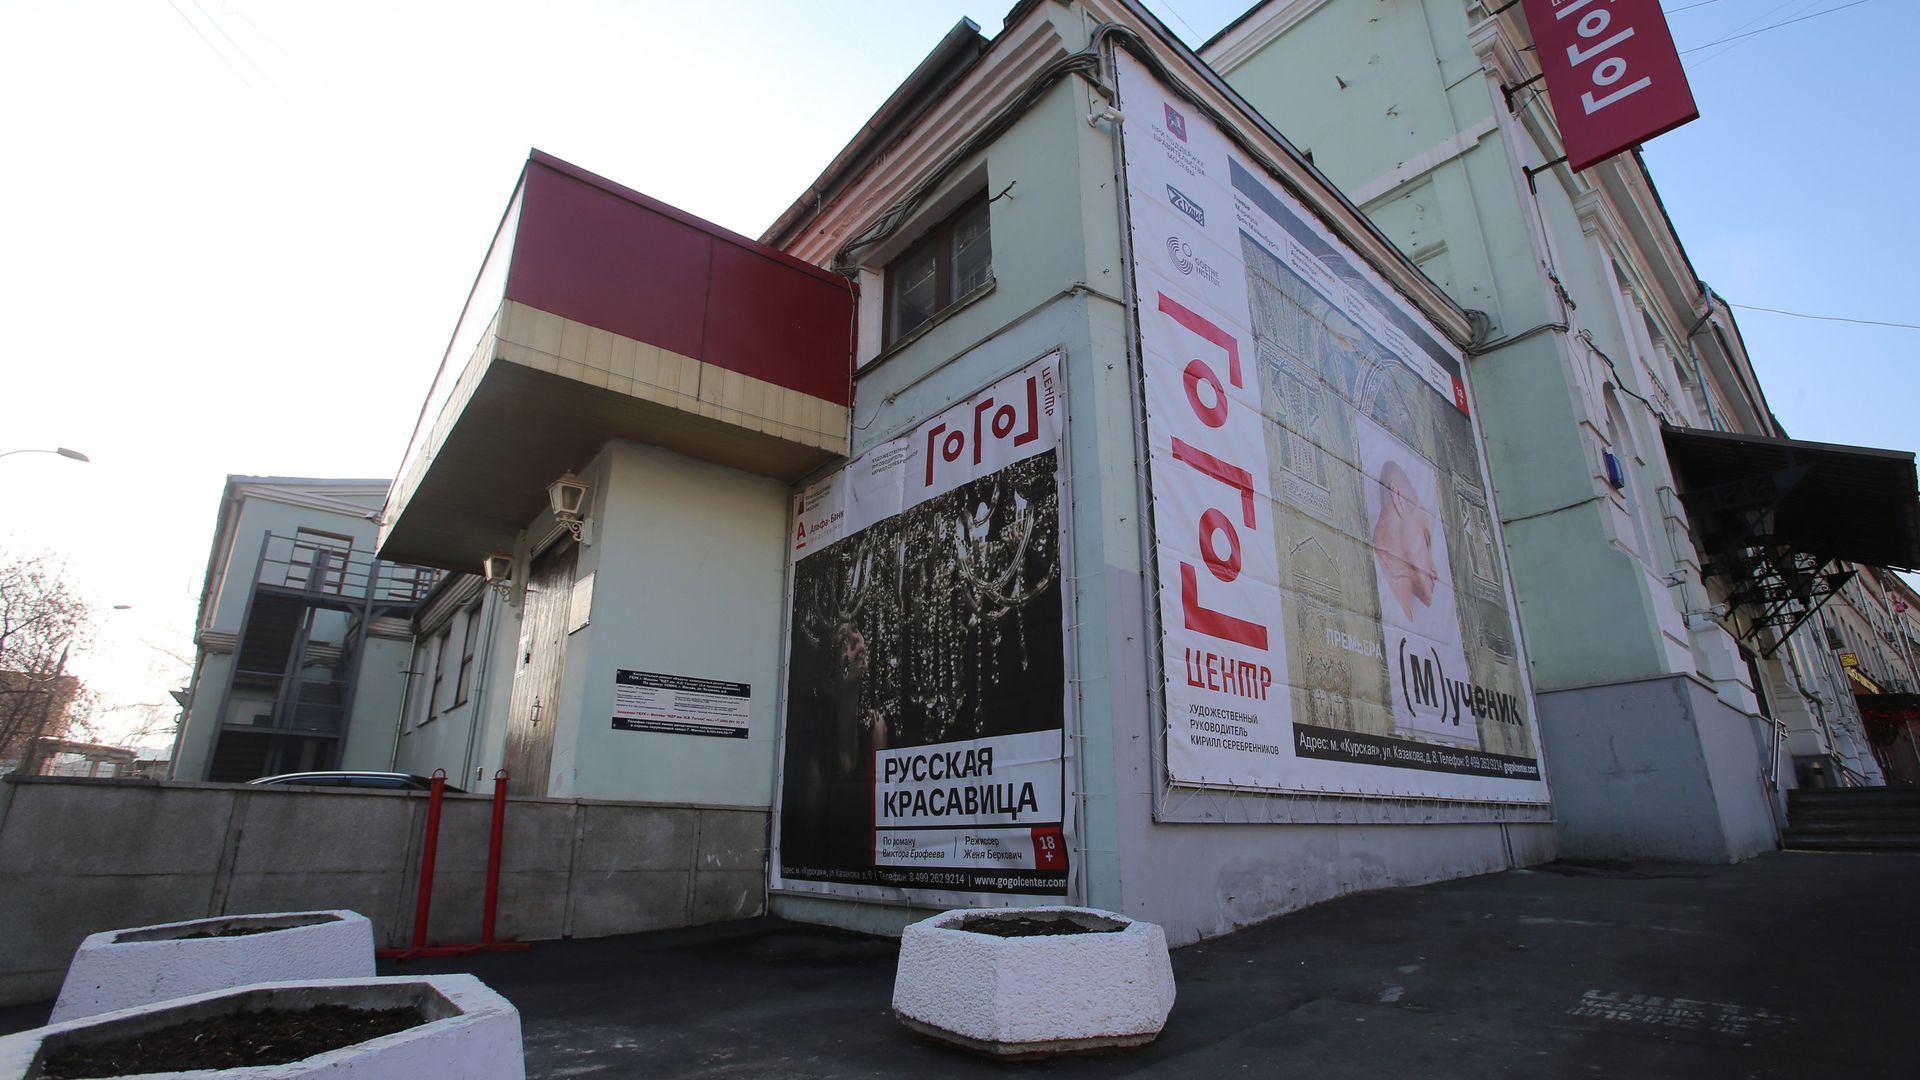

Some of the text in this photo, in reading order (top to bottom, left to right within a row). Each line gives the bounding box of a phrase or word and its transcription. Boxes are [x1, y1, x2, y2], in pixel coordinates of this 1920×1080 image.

[1326, 628, 1383, 660] ПРЕМЬЕРА
[1185, 647, 1272, 701] ЦЕНТР
[1189, 703, 1259, 726] ХУДОЖЕСТВЕННЫЙ
[1190, 719, 1249, 737] РУКОВОДИТЕЛЬ
[1190, 735, 1280, 756] КИРИЛЛ СЕРЕБРЕННИКОВ
[1300, 731, 1330, 752] Адрес:
[884, 746, 993, 784] РУССКАЯ
[883, 781, 1039, 821] КРАСАВИЦА
[882, 836, 916, 849] По роману
[964, 835, 1001, 848] Режиссер
[882, 848, 945, 861] Виктора Ерофеева
[963, 849, 1023, 862] Женя Беркович
[910, 872, 915, 882] 8
[916, 873, 929, 883] 499
[930, 873, 944, 884] 262
[946, 873, 965, 885] 9214
[974, 876, 1067, 890] www.gogolcenter.com
